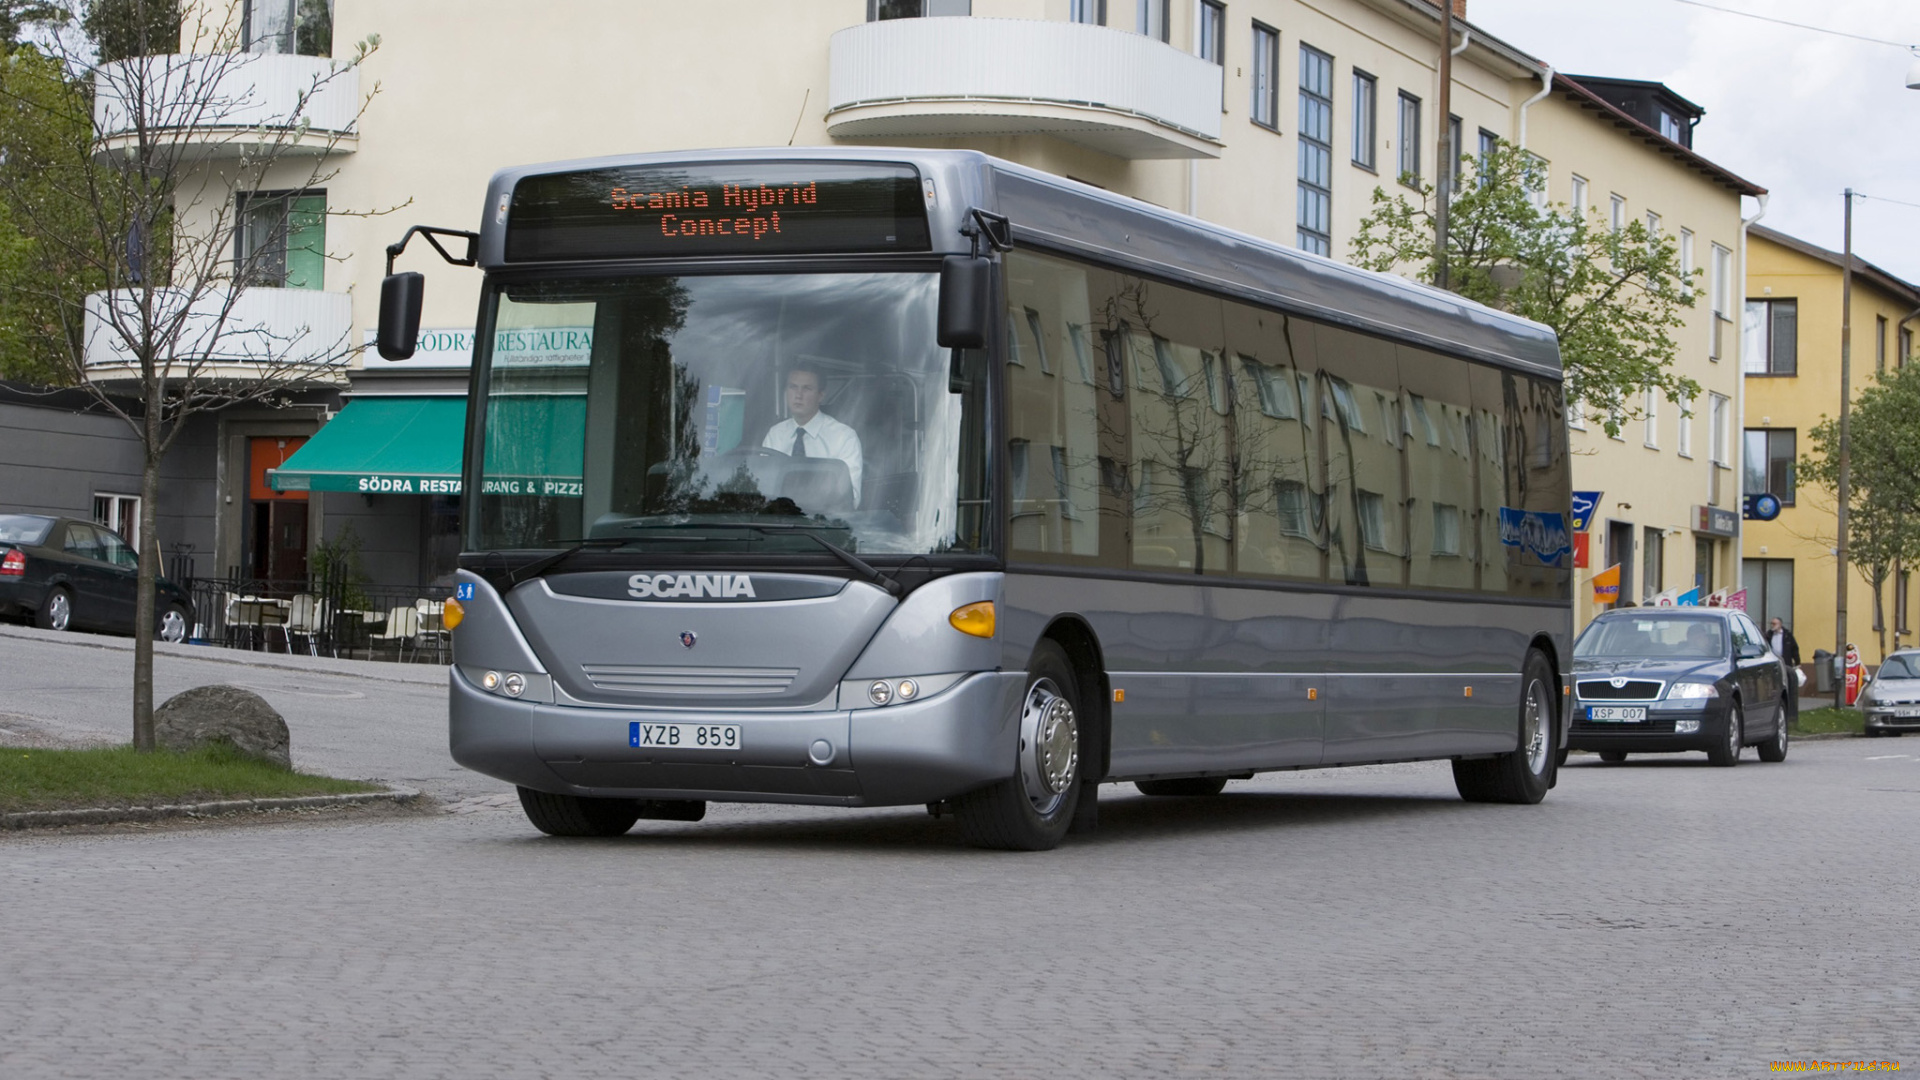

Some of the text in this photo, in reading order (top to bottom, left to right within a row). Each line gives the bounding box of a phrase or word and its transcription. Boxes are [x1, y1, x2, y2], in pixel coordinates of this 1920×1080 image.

[611, 181, 817, 211] Scania Hybrid
[661, 211, 781, 239] Concept
[358, 476, 413, 492] SÖDRA
[526, 481, 536, 493] &
[627, 574, 757, 598] SCANIA
[1593, 708, 1644, 719] XSP 007
[642, 725, 681, 745] XZB
[696, 726, 736, 747] 859
